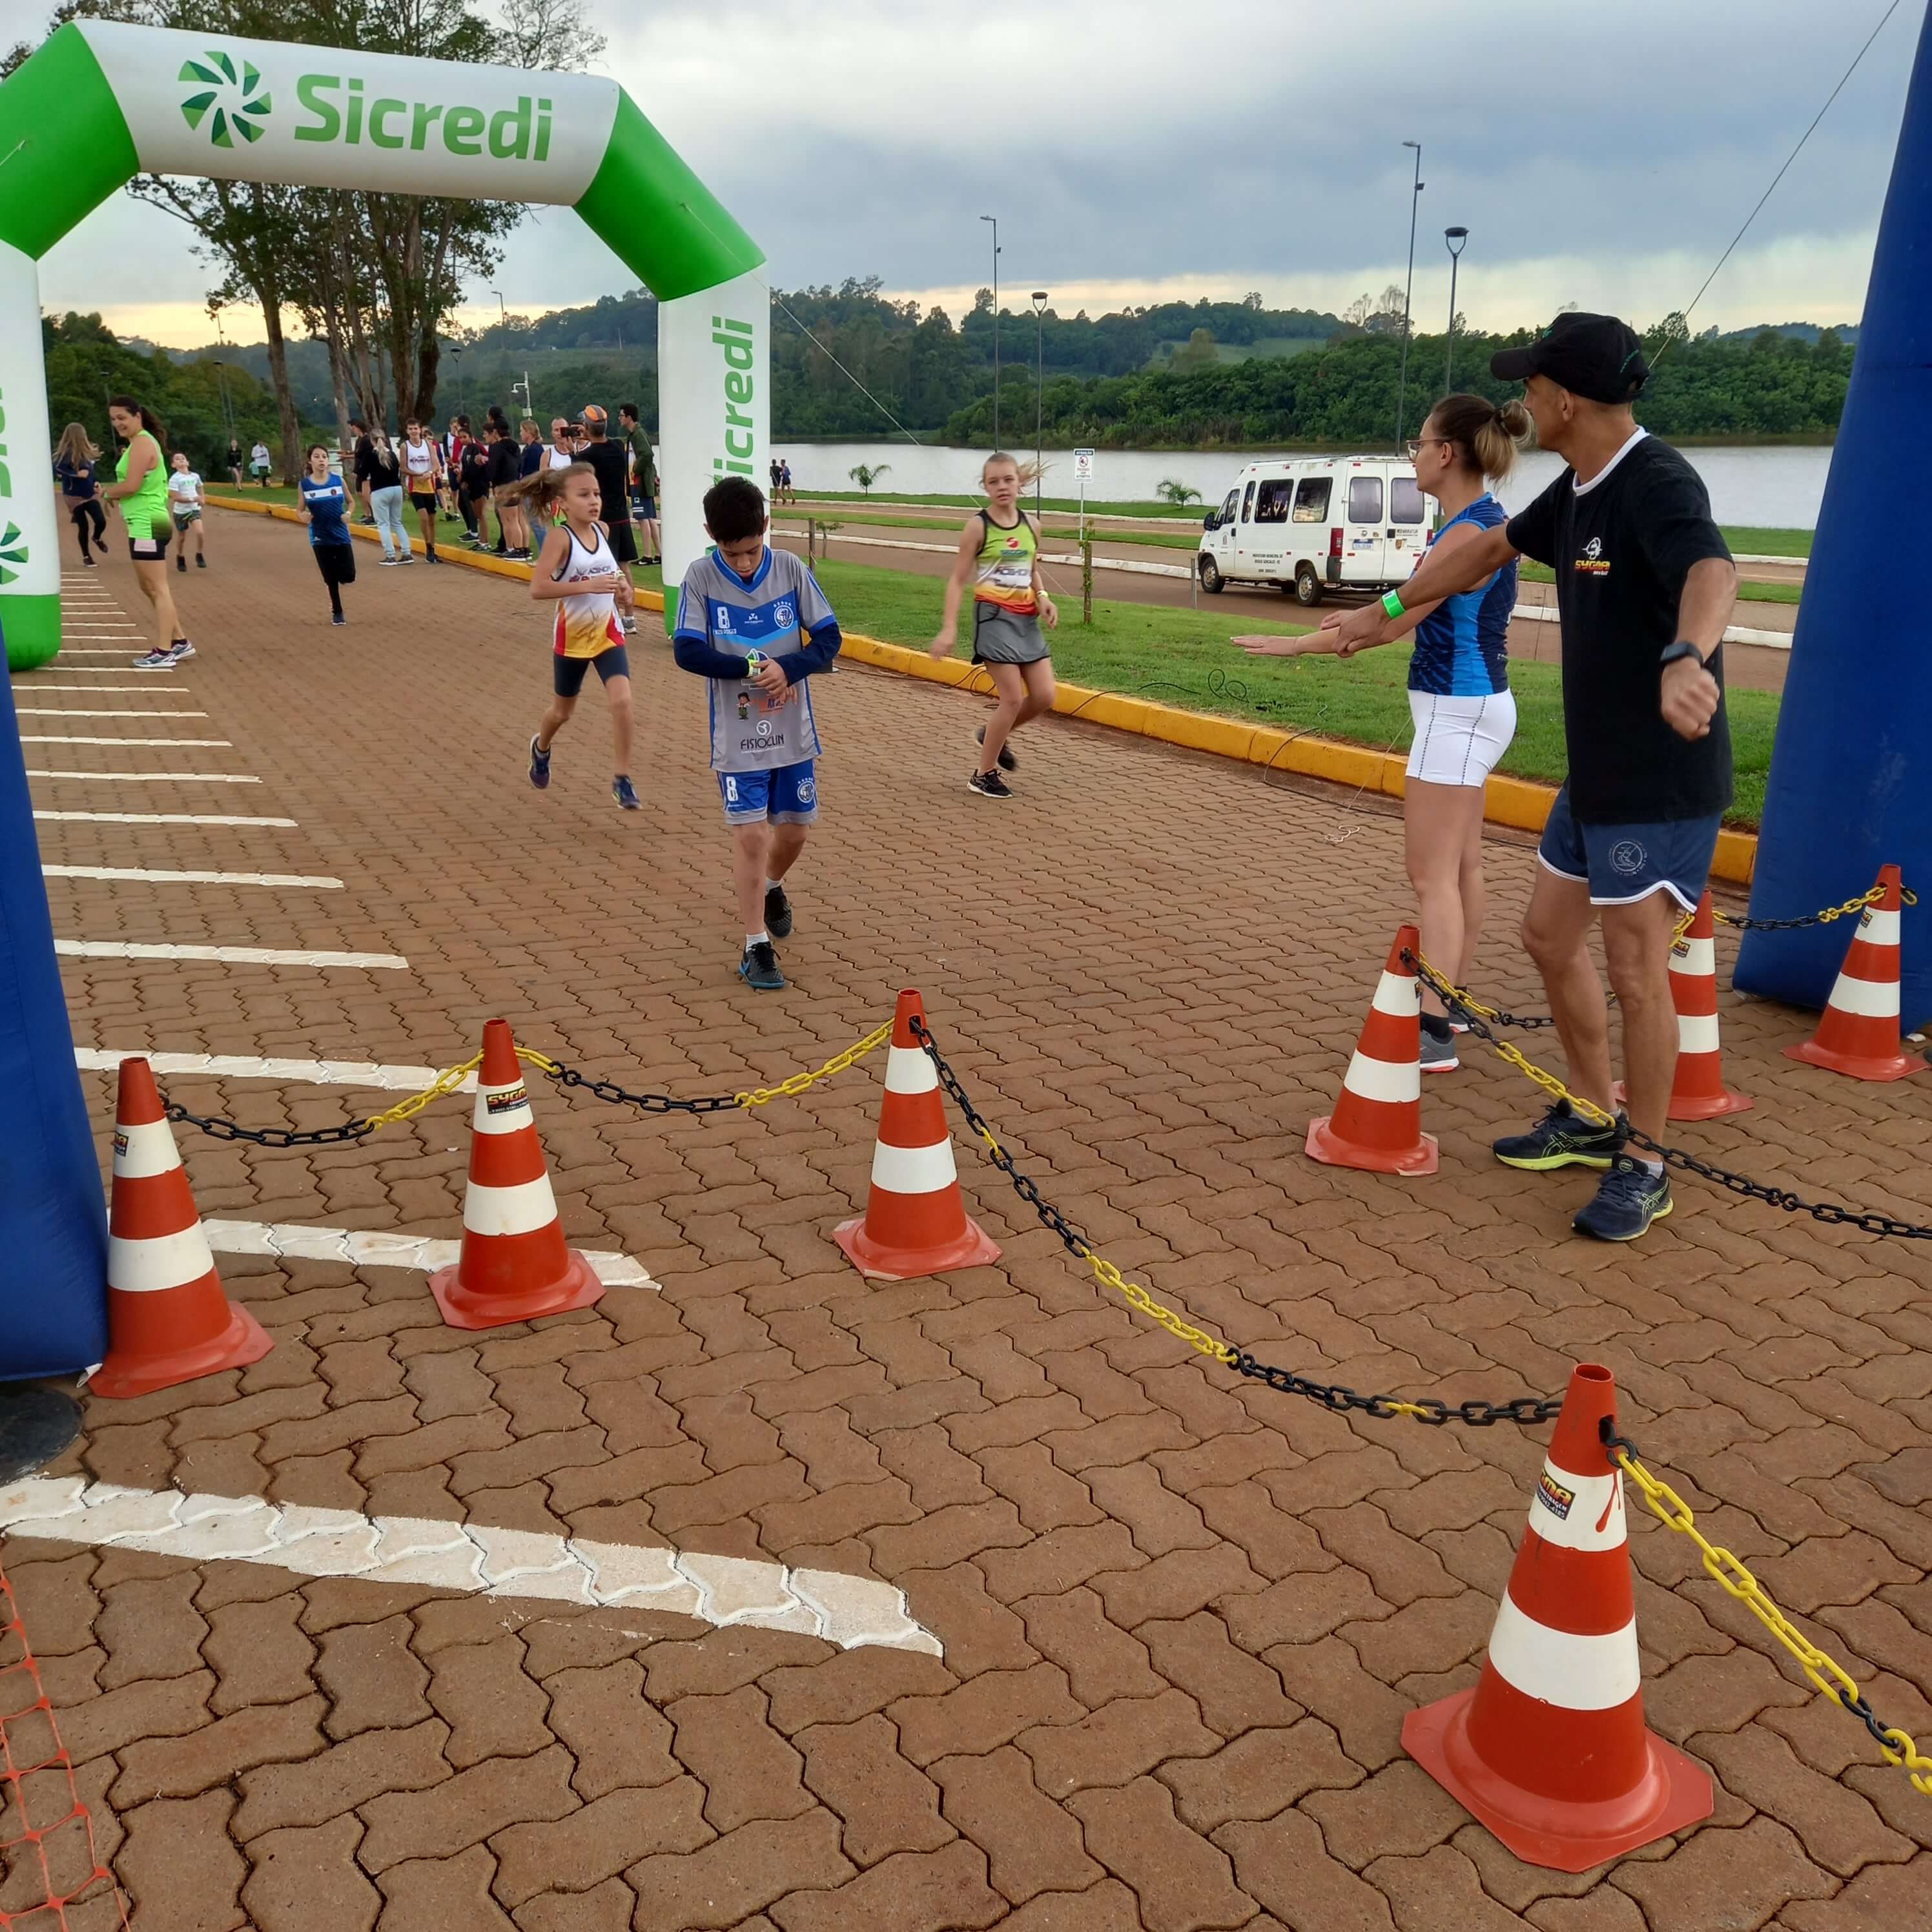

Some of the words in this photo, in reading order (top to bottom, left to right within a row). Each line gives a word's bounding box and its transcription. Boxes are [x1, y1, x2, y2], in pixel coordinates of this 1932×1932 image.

[294, 74, 552, 162] Sicredi
[712, 315, 754, 486] icredi
[717, 606, 730, 629] 8
[740, 734, 785, 750] FISIOCLIN
[726, 776, 739, 801] 8
